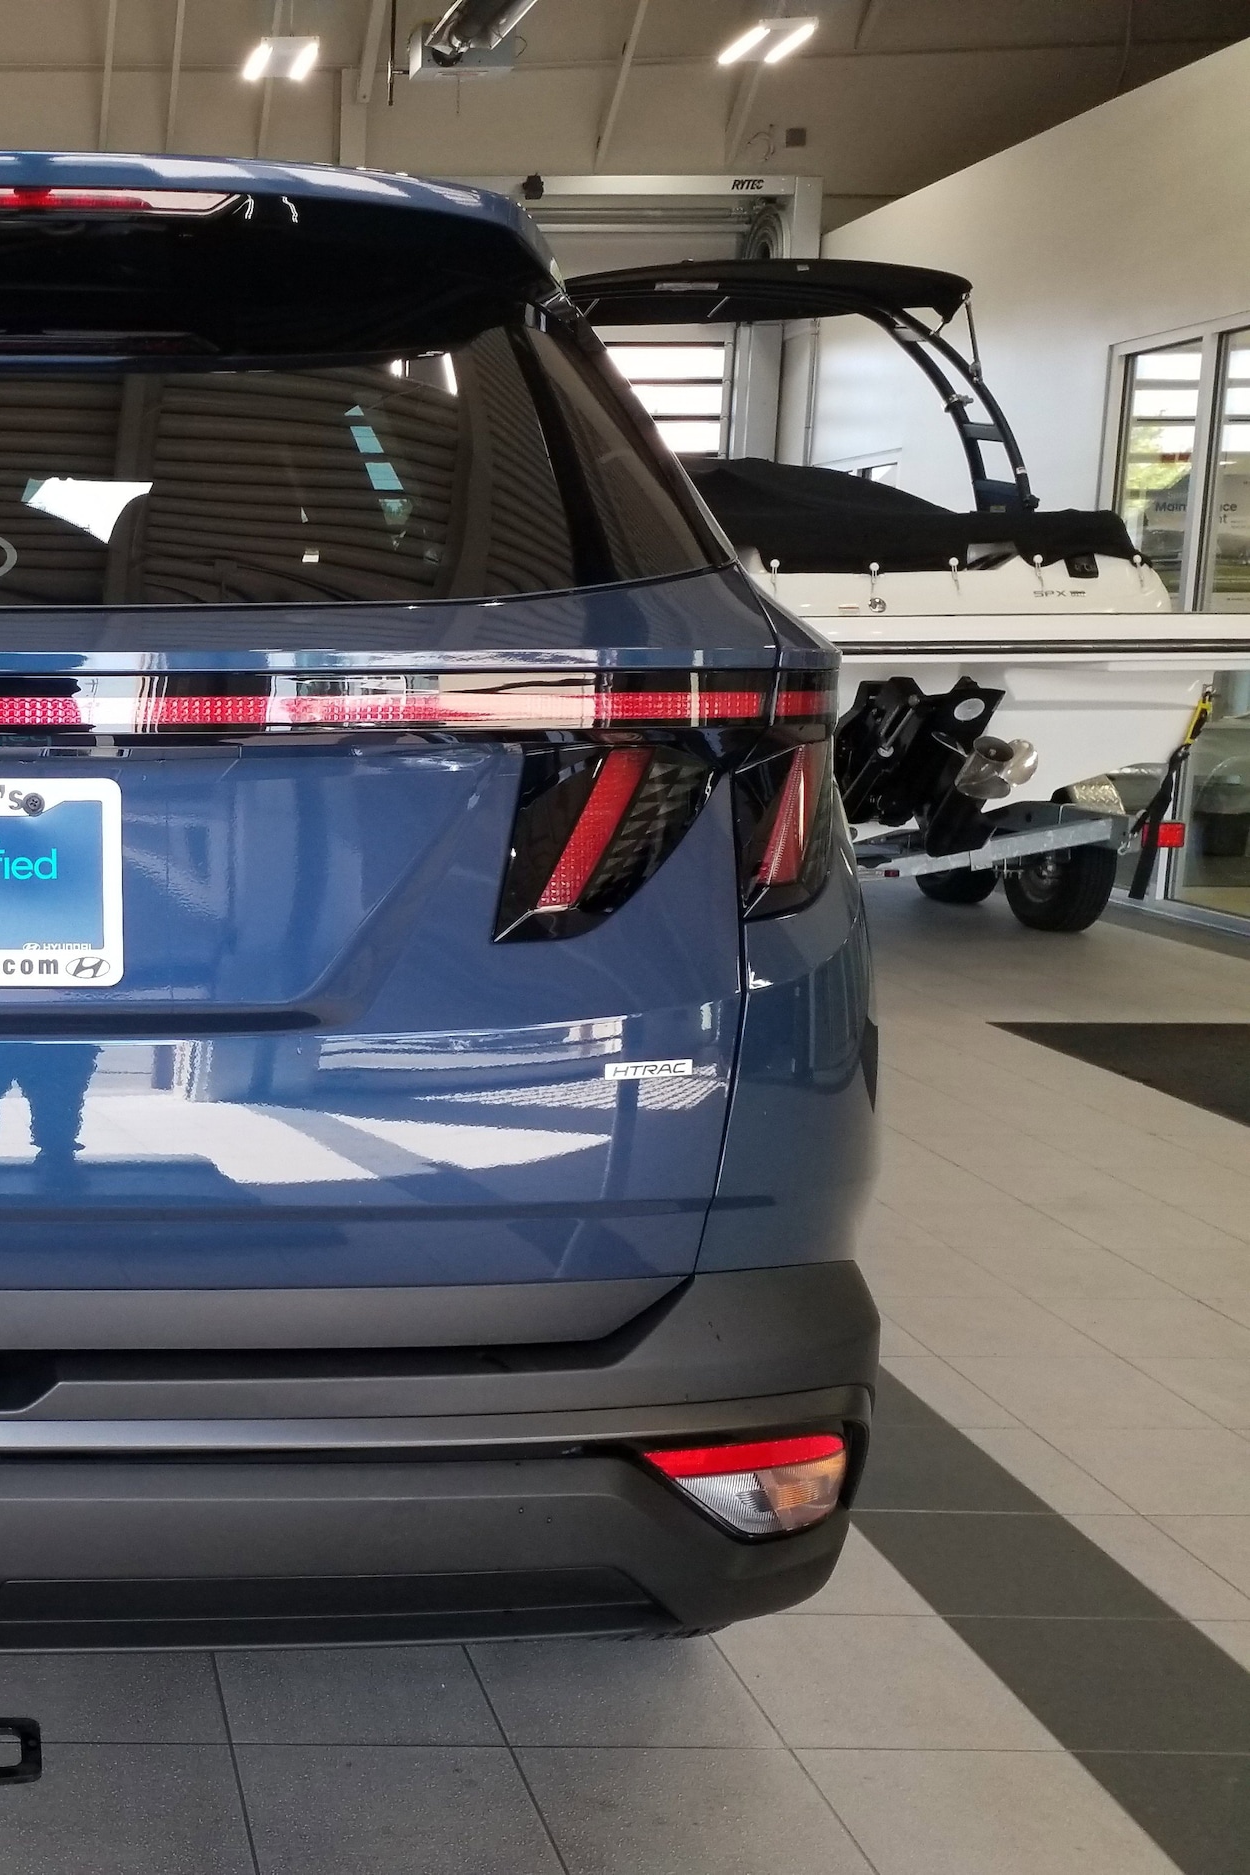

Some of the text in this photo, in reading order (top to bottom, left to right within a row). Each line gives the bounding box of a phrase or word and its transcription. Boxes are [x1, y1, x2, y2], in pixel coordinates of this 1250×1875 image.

[731, 179, 765, 191] RYTEC
[1033, 590, 1067, 598] SPX
[612, 1063, 687, 1077] HTRAC
